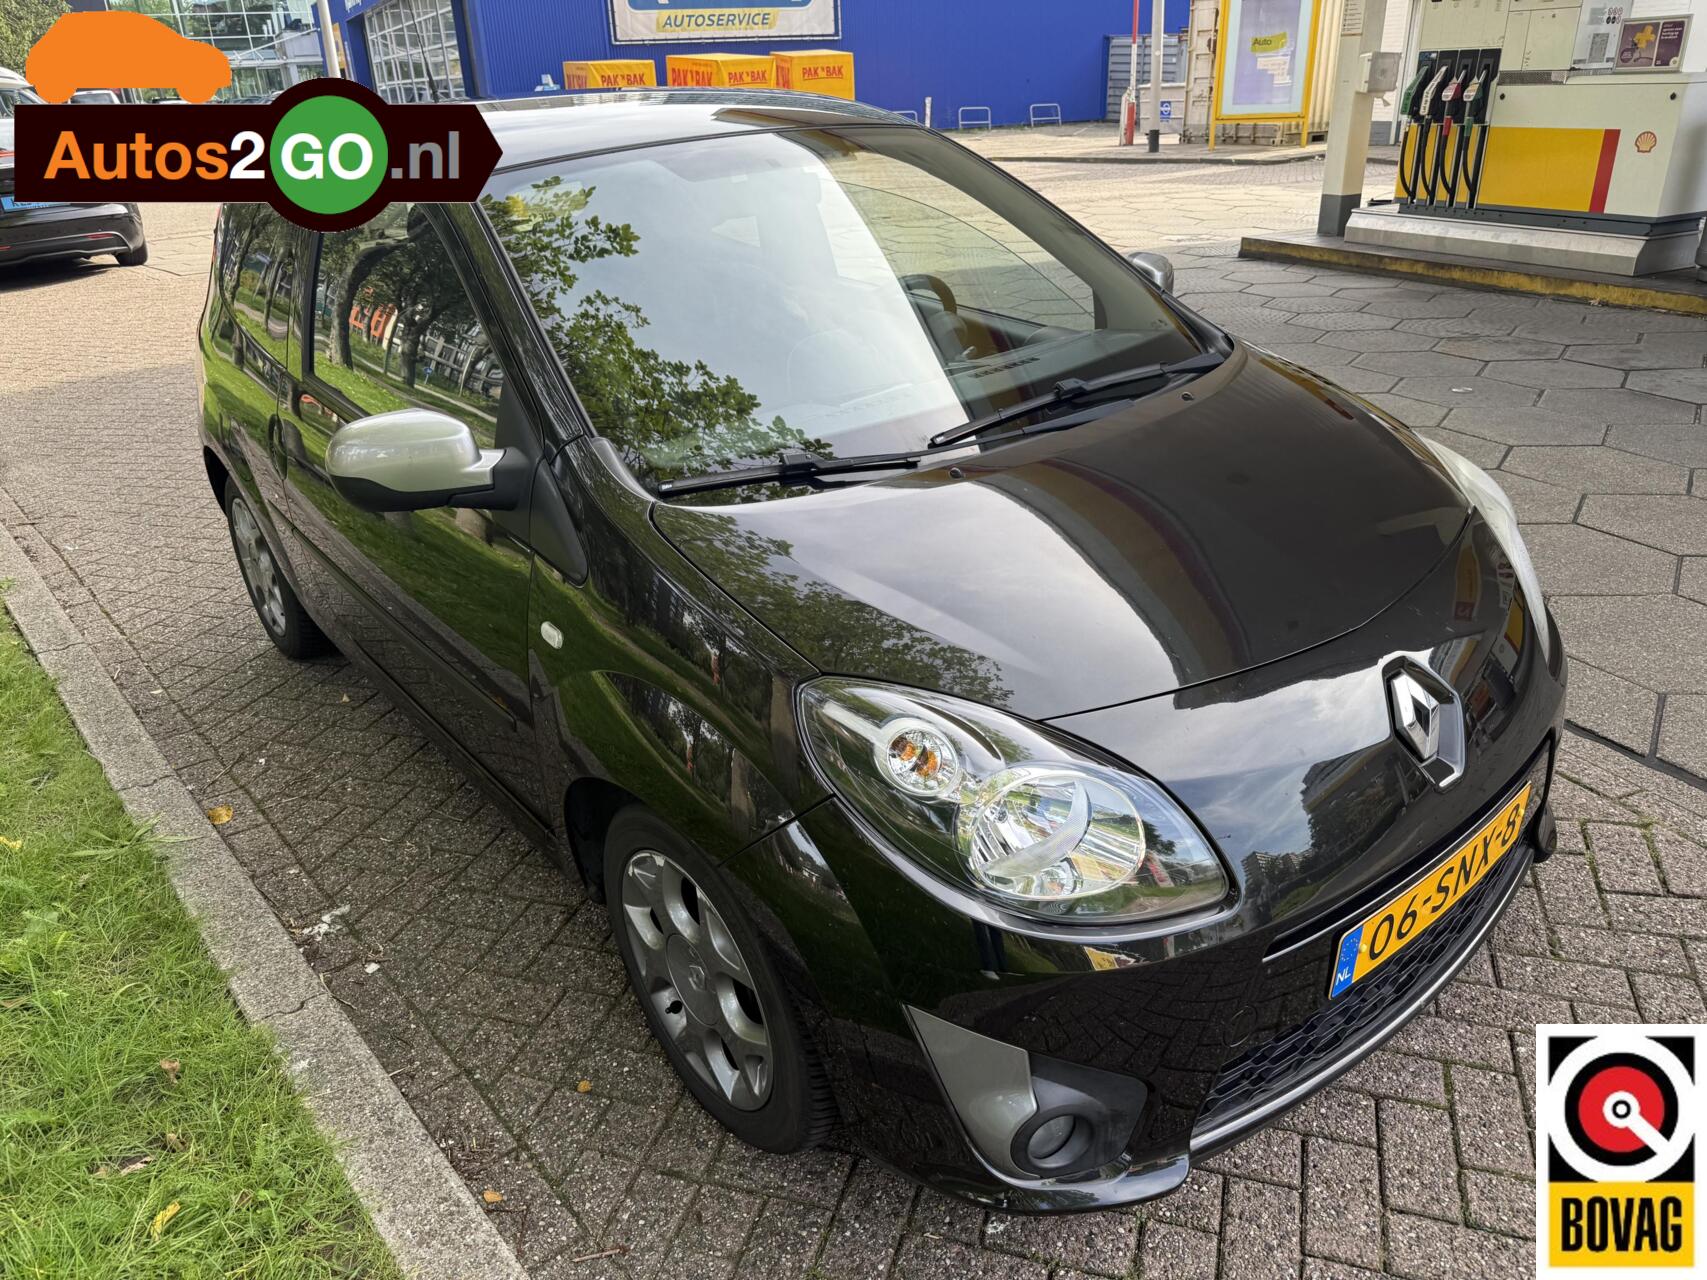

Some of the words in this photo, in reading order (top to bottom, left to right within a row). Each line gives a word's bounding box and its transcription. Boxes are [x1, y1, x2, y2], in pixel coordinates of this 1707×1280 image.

[662, 13, 771, 28] AUTOSERVICE
[1252, 38, 1272, 46] Auto
[600, 74, 619, 87] PAK
[626, 73, 646, 86] BAK
[728, 71, 744, 84] PAK
[750, 70, 767, 82] BAK
[802, 66, 819, 80] PAK
[826, 65, 844, 77] BAK
[1368, 802, 1521, 961] 06-SNX-8
[1335, 966, 1352, 986] NL
